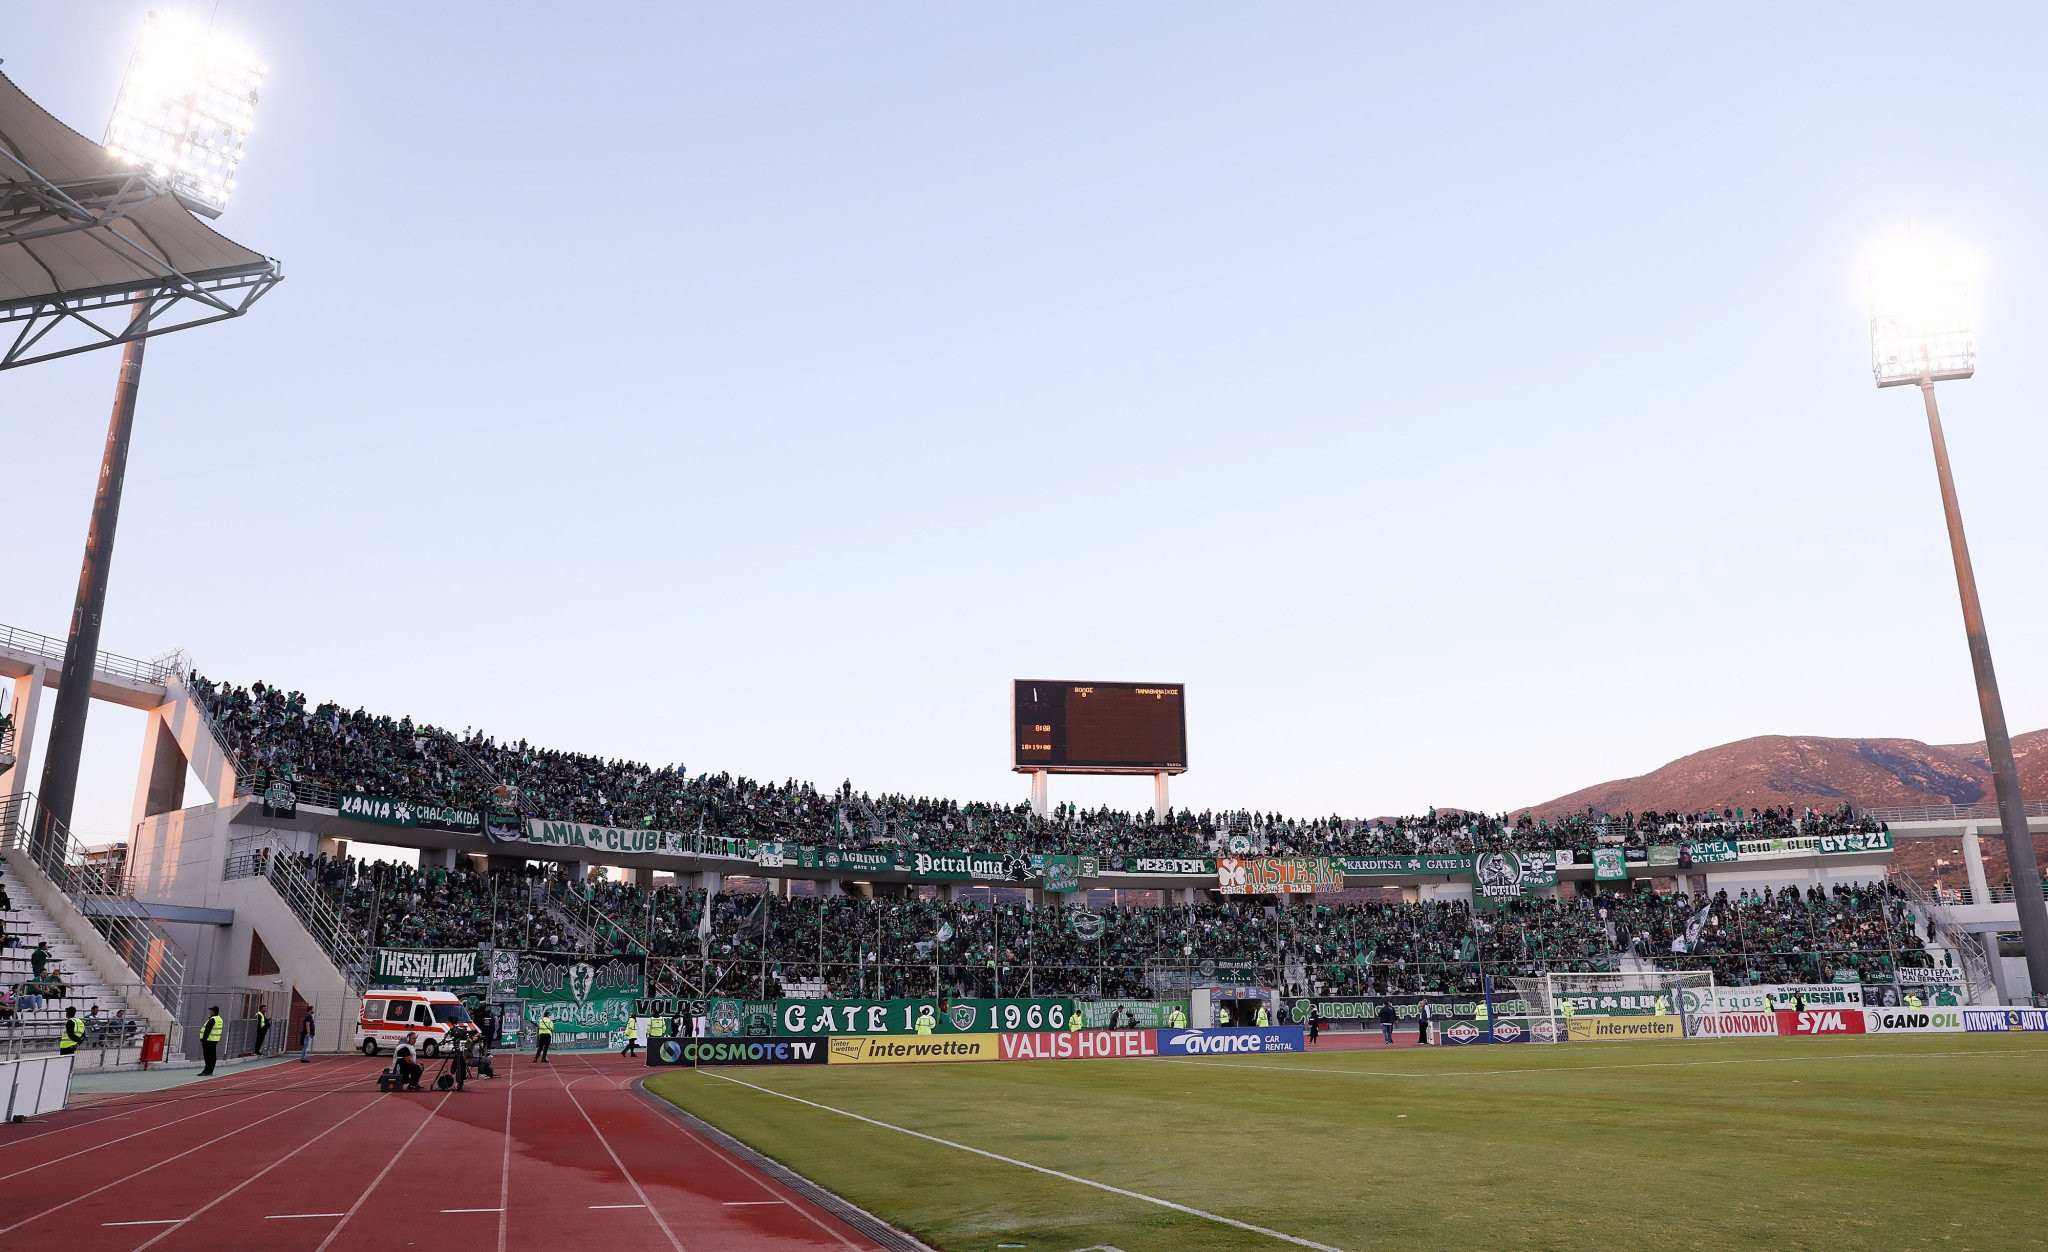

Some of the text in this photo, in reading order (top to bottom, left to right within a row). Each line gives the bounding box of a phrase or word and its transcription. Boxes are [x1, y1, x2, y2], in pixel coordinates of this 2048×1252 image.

[416, 806, 441, 820] CHAL
[456, 812, 480, 825] KIDA
[528, 821, 658, 850] LAMIA CLUB
[1691, 843, 1729, 853] NEMEA
[1739, 843, 1770, 853] EGIO
[842, 852, 887, 867] AGRINIO
[915, 852, 1003, 875] Petralona
[1347, 857, 1471, 869] KARDITSA GATE 13
[380, 950, 477, 977] THESSALONIKI
[1847, 992, 1860, 1003] 13
[635, 999, 706, 1016] VOLOS
[1318, 1002, 1374, 1018] JORDAN
[784, 1004, 888, 1032] GATE
[989, 1005, 1064, 1030] 1966
[1797, 1012, 1846, 1031] SYM
[1884, 1013, 1961, 1029] GAND OIL
[1964, 1011, 2008, 1031] ΛΥΚΟΥΡΗΣ
[1596, 1021, 1674, 1034] interwetten
[684, 1042, 816, 1061] COSMOTE TV
[868, 1040, 980, 1057] interwetten
[1001, 1031, 1155, 1058] VALIS HOTEL
[1186, 1034, 1261, 1052] avance
[1265, 1042, 1293, 1051] RENTAL
